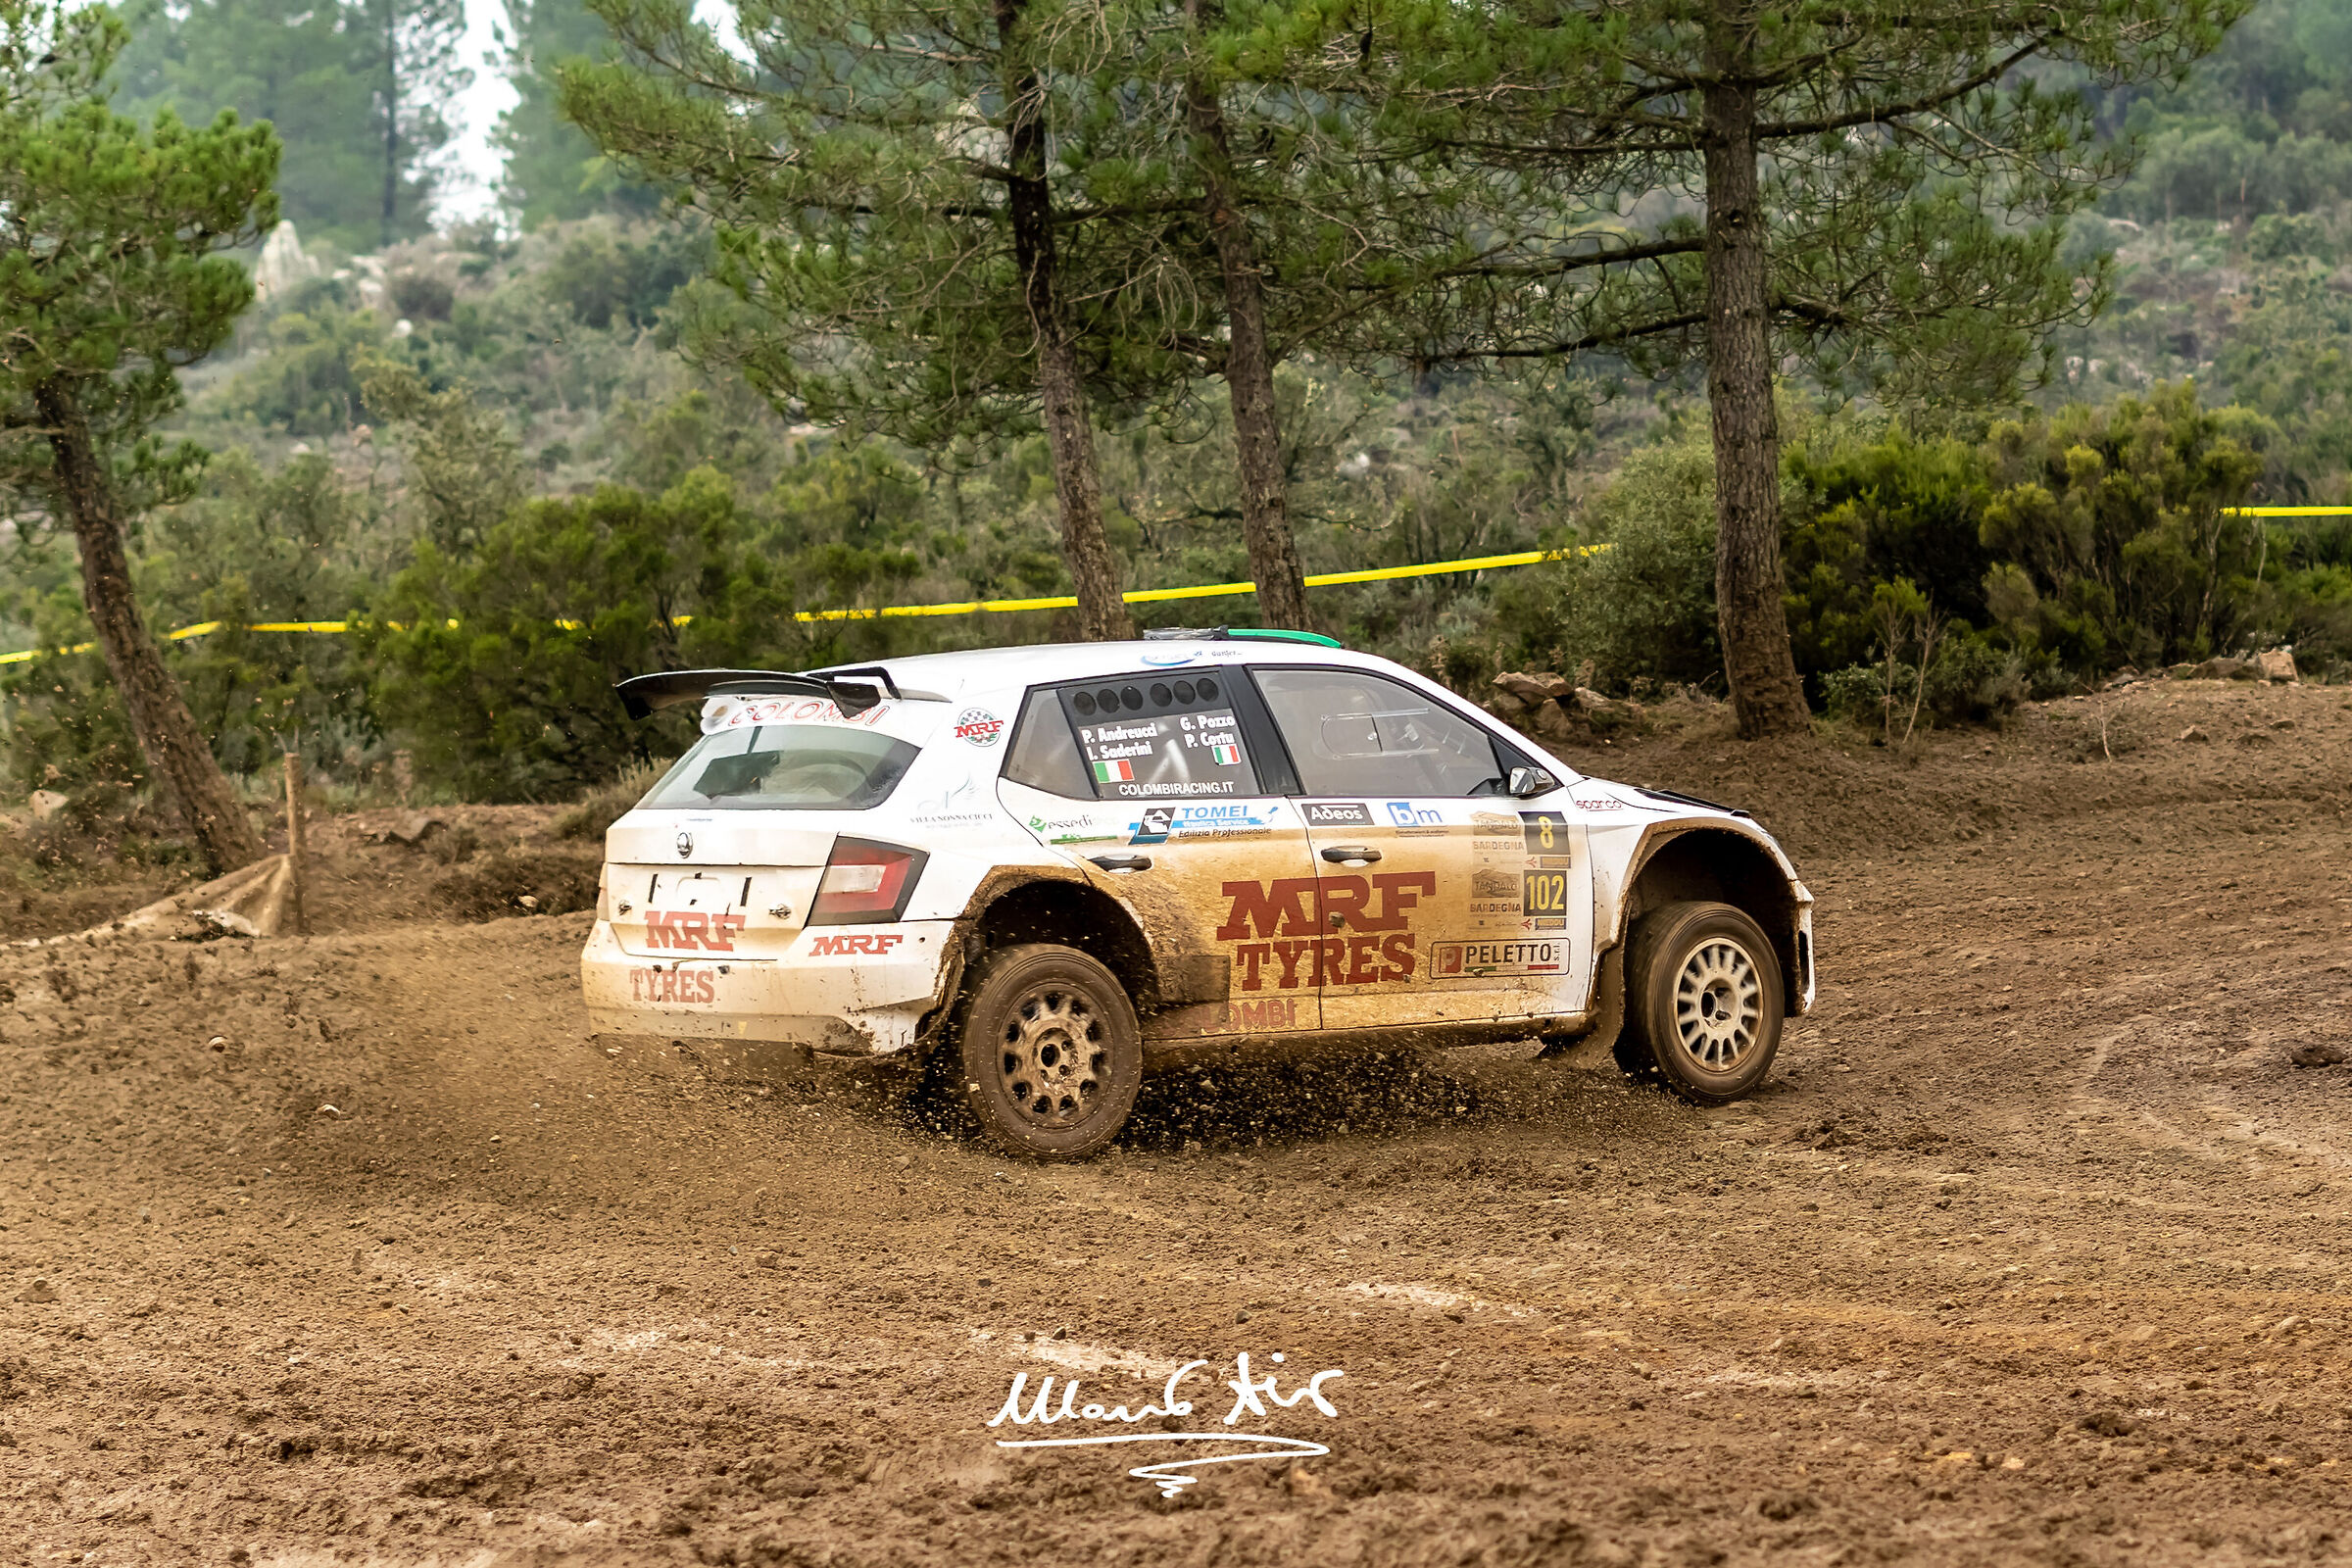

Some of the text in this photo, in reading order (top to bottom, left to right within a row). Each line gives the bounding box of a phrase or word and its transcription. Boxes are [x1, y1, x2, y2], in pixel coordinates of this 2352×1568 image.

[954, 720, 1004, 738] MRF
[1081, 722, 1158, 744] P. Andreucci
[1180, 716, 1196, 731] G.
[1184, 733, 1199, 748] P.
[1118, 781, 1235, 796] COLOMBIRACING.IT
[1181, 806, 1248, 819] TOMEI
[1576, 800, 1622, 808] sparco
[1048, 814, 1093, 830] essedi
[1538, 815, 1554, 849] 8
[1473, 841, 1525, 851] SARDEGNA
[1526, 875, 1565, 911] 102
[1216, 871, 1436, 941] MRF
[1470, 904, 1522, 913] SARDEGNA
[644, 910, 746, 952] MRF
[808, 935, 904, 956] MRF
[1465, 943, 1551, 964] PELETTO
[1236, 934, 1416, 992] TYRES
[629, 969, 715, 1004] TYRES
